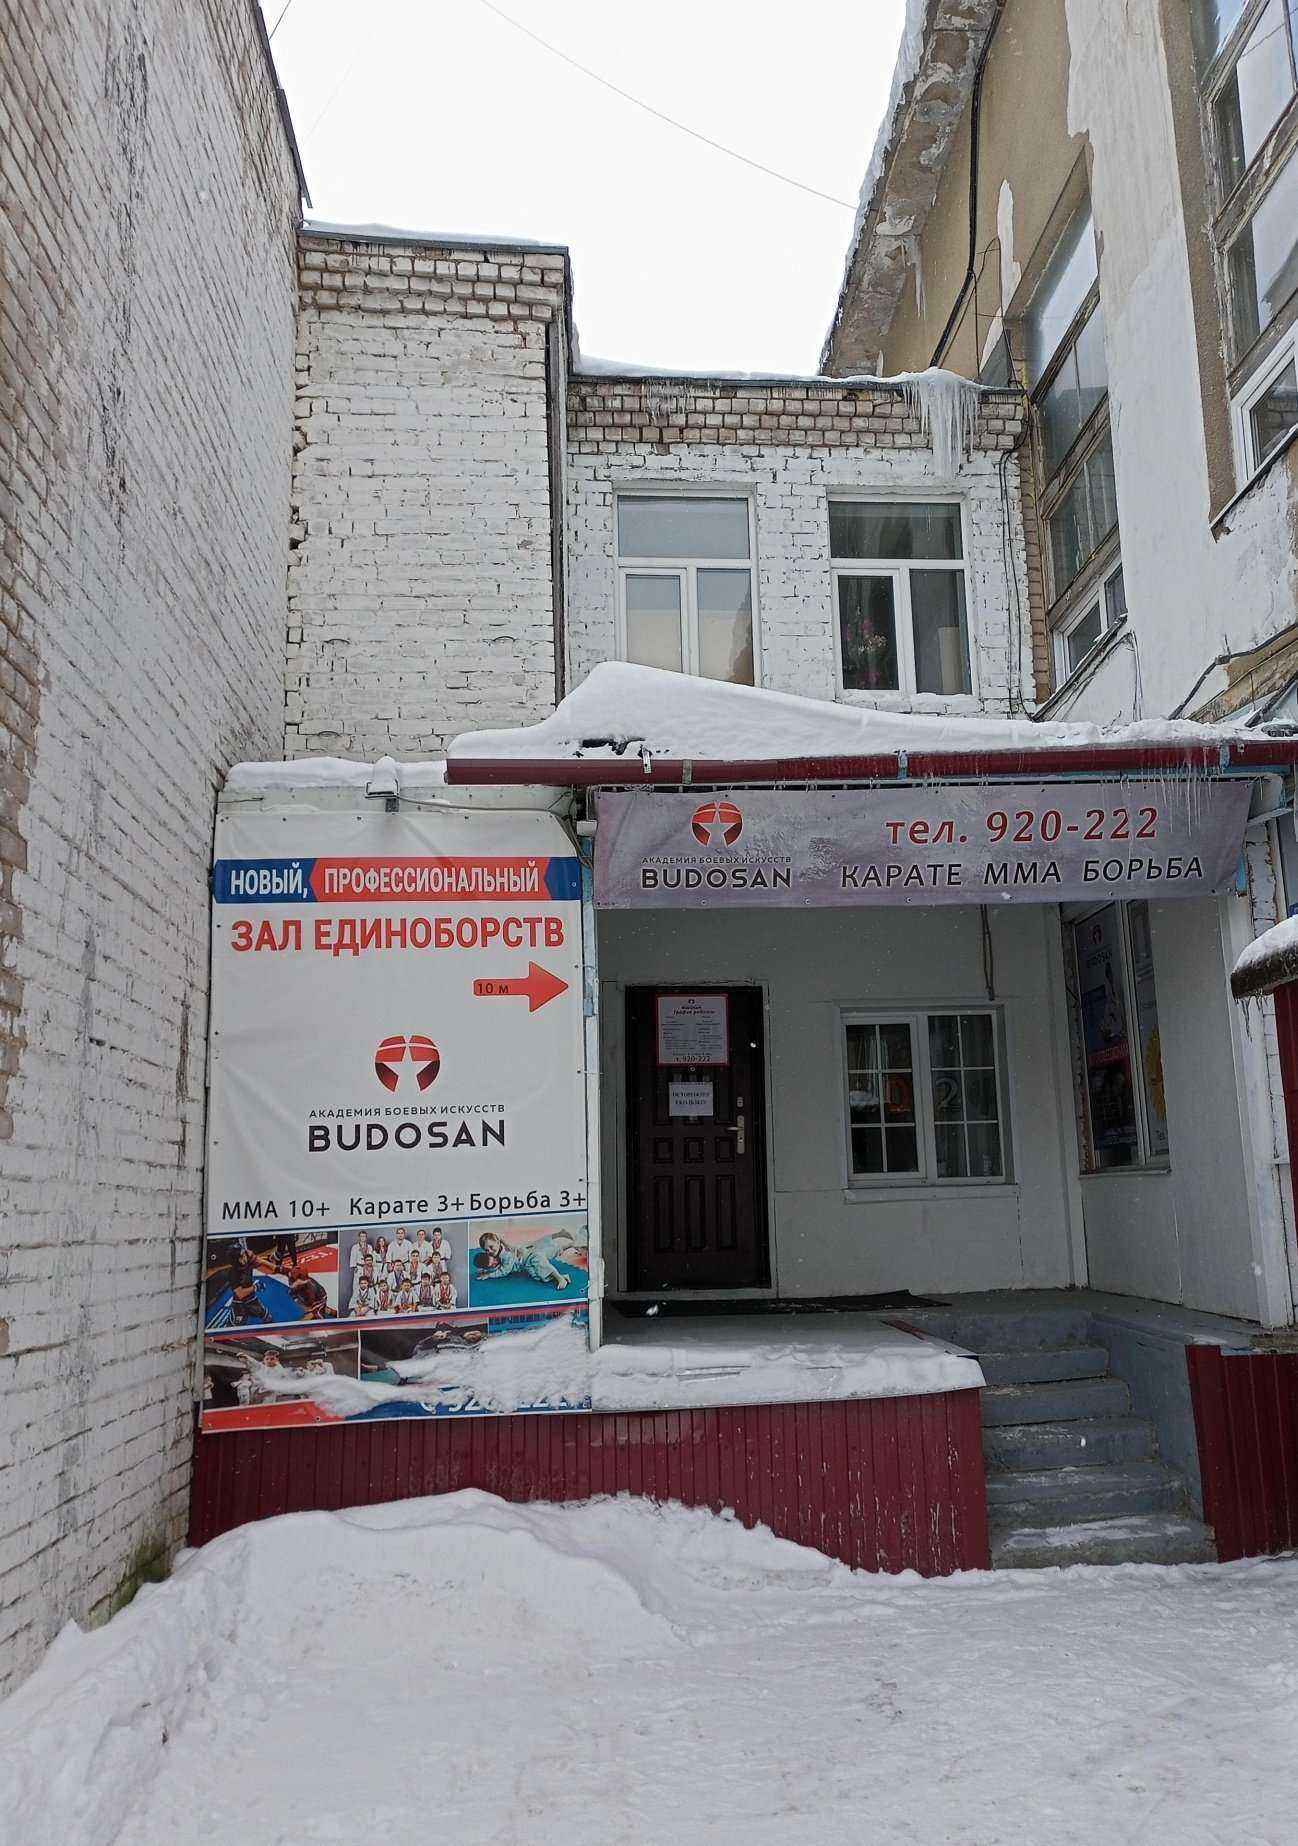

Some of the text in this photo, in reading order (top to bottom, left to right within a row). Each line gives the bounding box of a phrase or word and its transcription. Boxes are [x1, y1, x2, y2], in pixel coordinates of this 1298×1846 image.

[885, 807, 1159, 845] тел. 920-222
[641, 856, 792, 864] АКАДЕМИЯ БОЕВЫХ ИСКУССТВ
[841, 856, 1203, 888] КАРАТЕ ММА БОРЬБА
[230, 860, 539, 899] НОВЫЙ, ПРОФЕССИОНАЛЬНЫЙ
[641, 867, 791, 889] BUDOSAN
[231, 916, 565, 956] ЗАЛ ЕДИНОБОРСТВ
[477, 982, 494, 995] 10
[309, 1104, 505, 1118] АКАДЕМИЯ БОЕВЫХ ИСКУССТВ
[308, 1119, 506, 1153] BUDOSAN
[289, 1199, 331, 1218] 10+
[350, 1197, 428, 1220] Карате
[437, 1195, 465, 1213] 3+
[470, 1191, 552, 1216] Борьба
[559, 1191, 587, 1208] 3+
